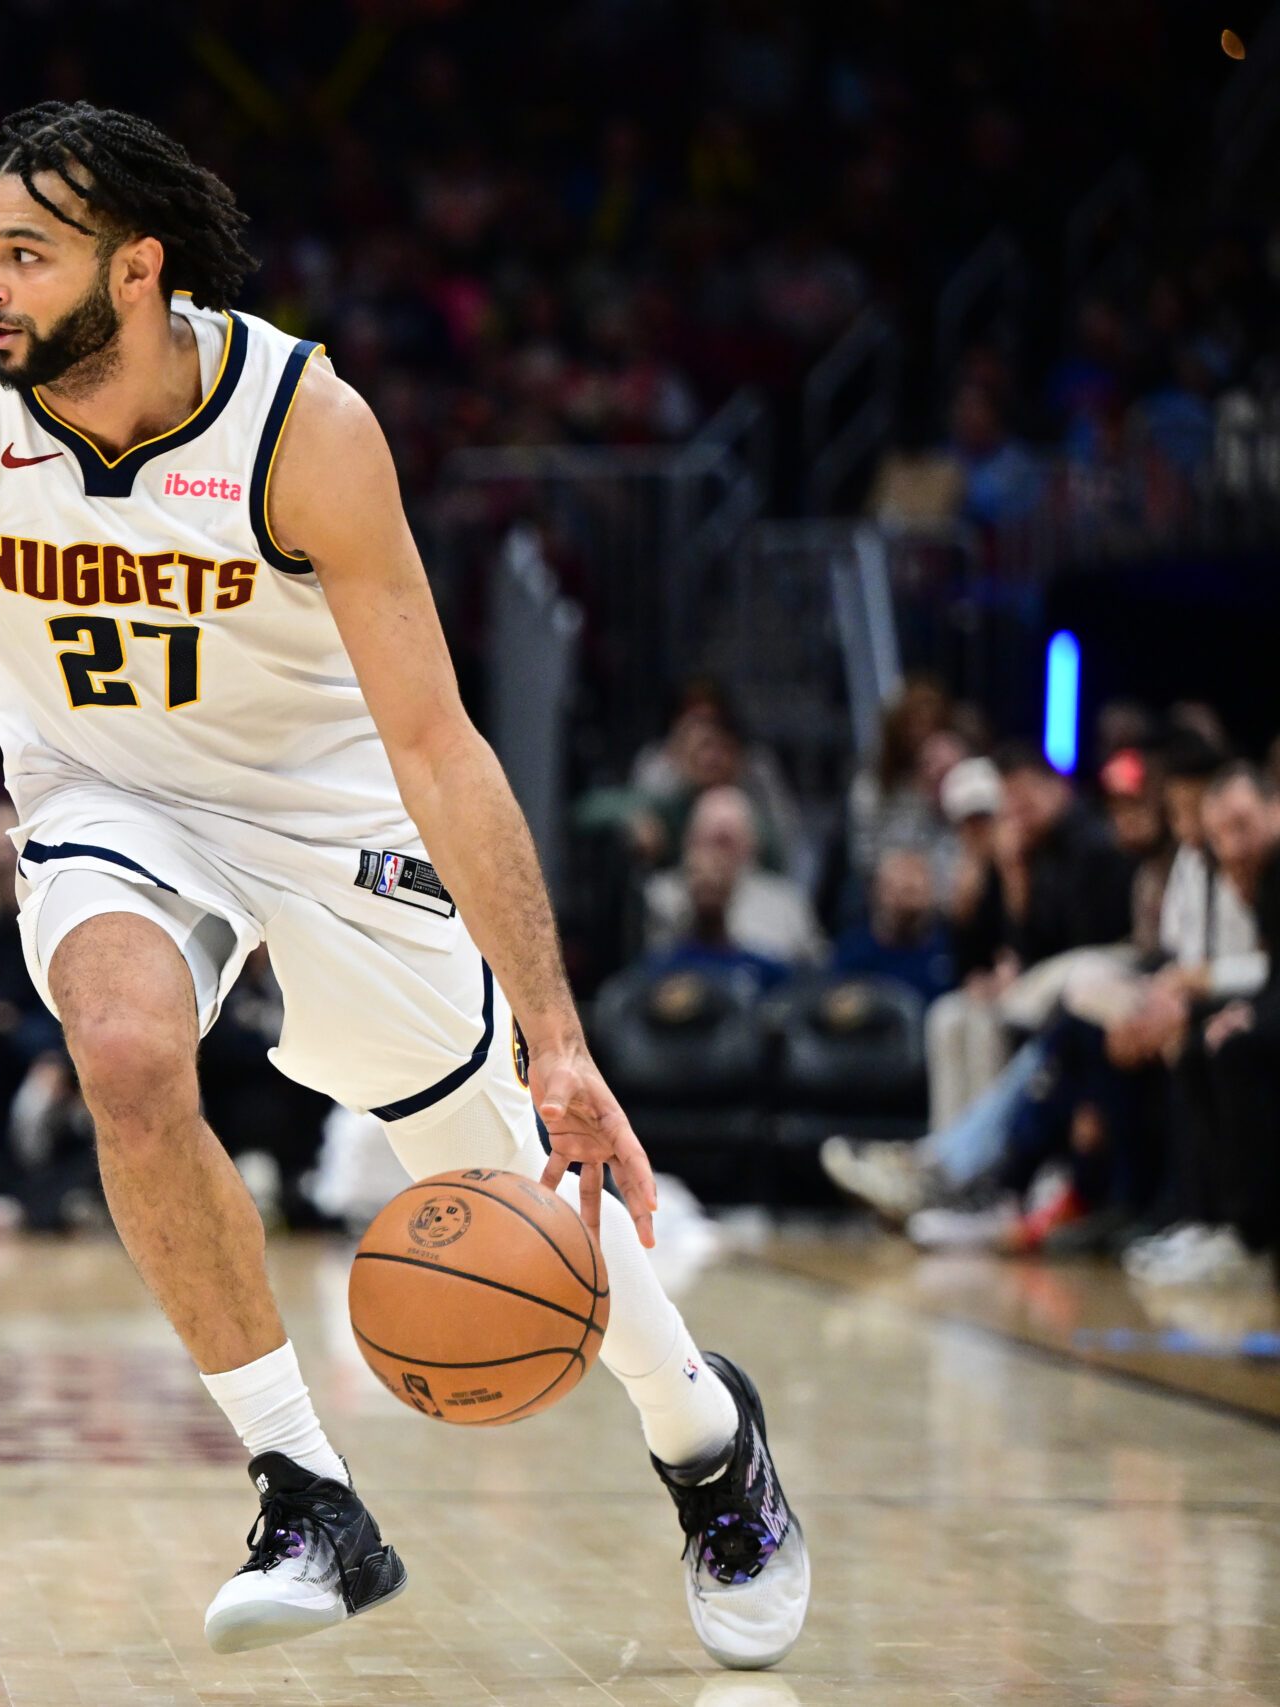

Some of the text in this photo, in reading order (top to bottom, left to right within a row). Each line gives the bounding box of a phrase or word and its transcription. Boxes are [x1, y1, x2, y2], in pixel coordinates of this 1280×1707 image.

[164, 473, 242, 502] ibotta
[44, 613, 203, 712] 27
[403, 869, 413, 879] 52
